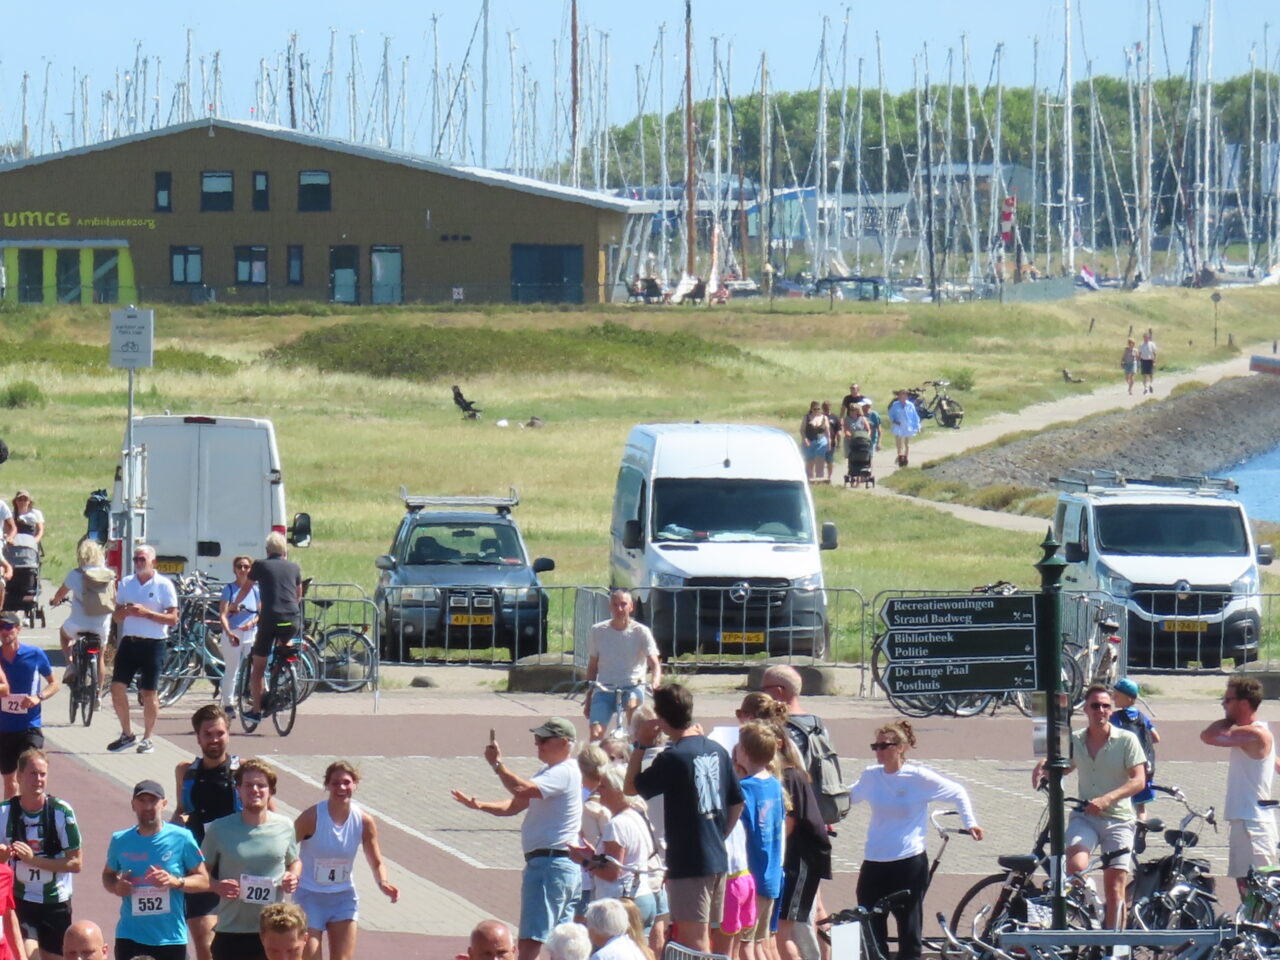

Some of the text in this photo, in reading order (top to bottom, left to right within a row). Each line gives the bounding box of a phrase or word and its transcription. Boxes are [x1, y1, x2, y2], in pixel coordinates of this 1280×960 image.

[894, 599, 995, 612] Recreatiewoningen
[894, 613, 973, 625] Strand Badweg
[895, 632, 954, 643] Bibliotheek
[895, 646, 929, 657] Politie
[895, 664, 969, 679] De Lange Paal
[895, 680, 941, 691] Posthuis
[29, 868, 40, 881] 71
[246, 886, 271, 901] 202
[138, 897, 163, 912] 552
